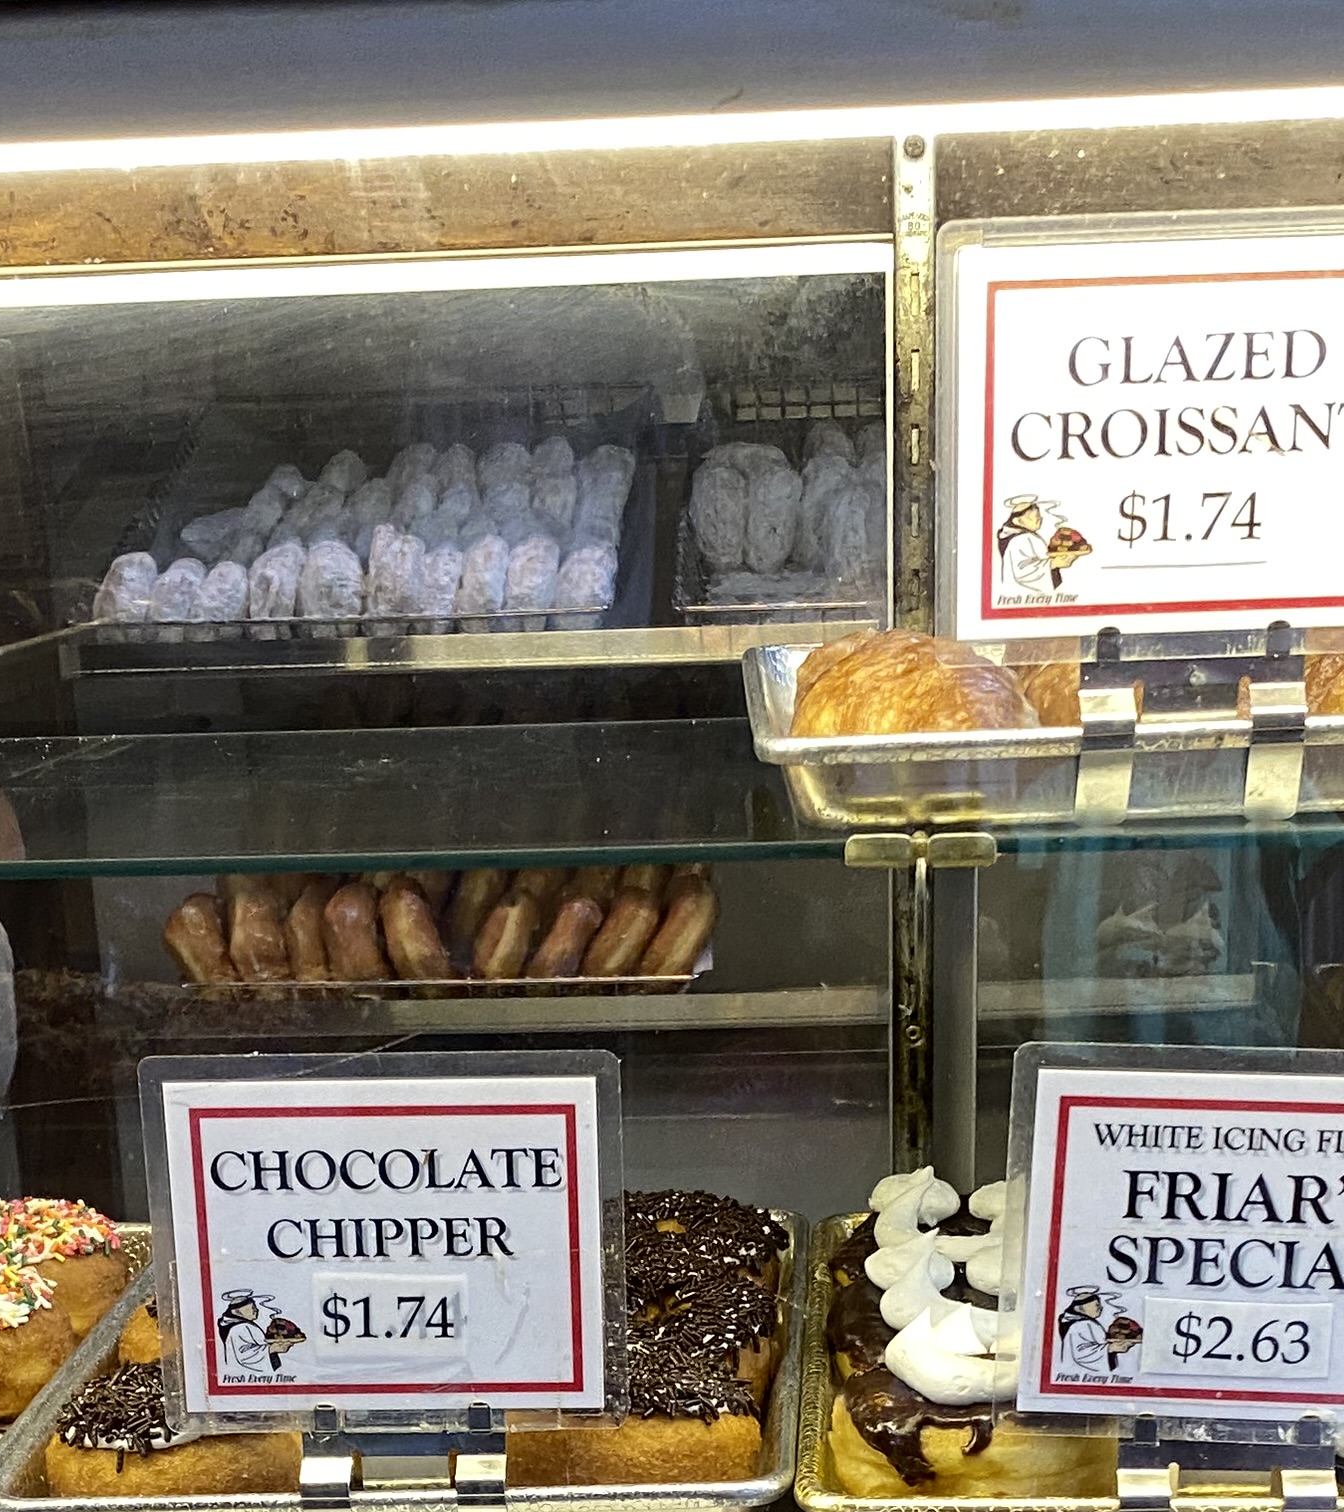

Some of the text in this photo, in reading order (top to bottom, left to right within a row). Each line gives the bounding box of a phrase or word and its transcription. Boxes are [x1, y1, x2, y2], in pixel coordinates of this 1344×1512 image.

[1068, 328, 1328, 387] GLAZED
[1117, 490, 1263, 548] $1.74
[1094, 1123, 1203, 1151] WHITE
[1212, 1127, 1306, 1153] ICING
[210, 1147, 562, 1192] CHOCOLATE
[267, 1217, 514, 1259] CHIPPER
[323, 1292, 455, 1344] $1.74
[1172, 1311, 1311, 1364] $2.63
